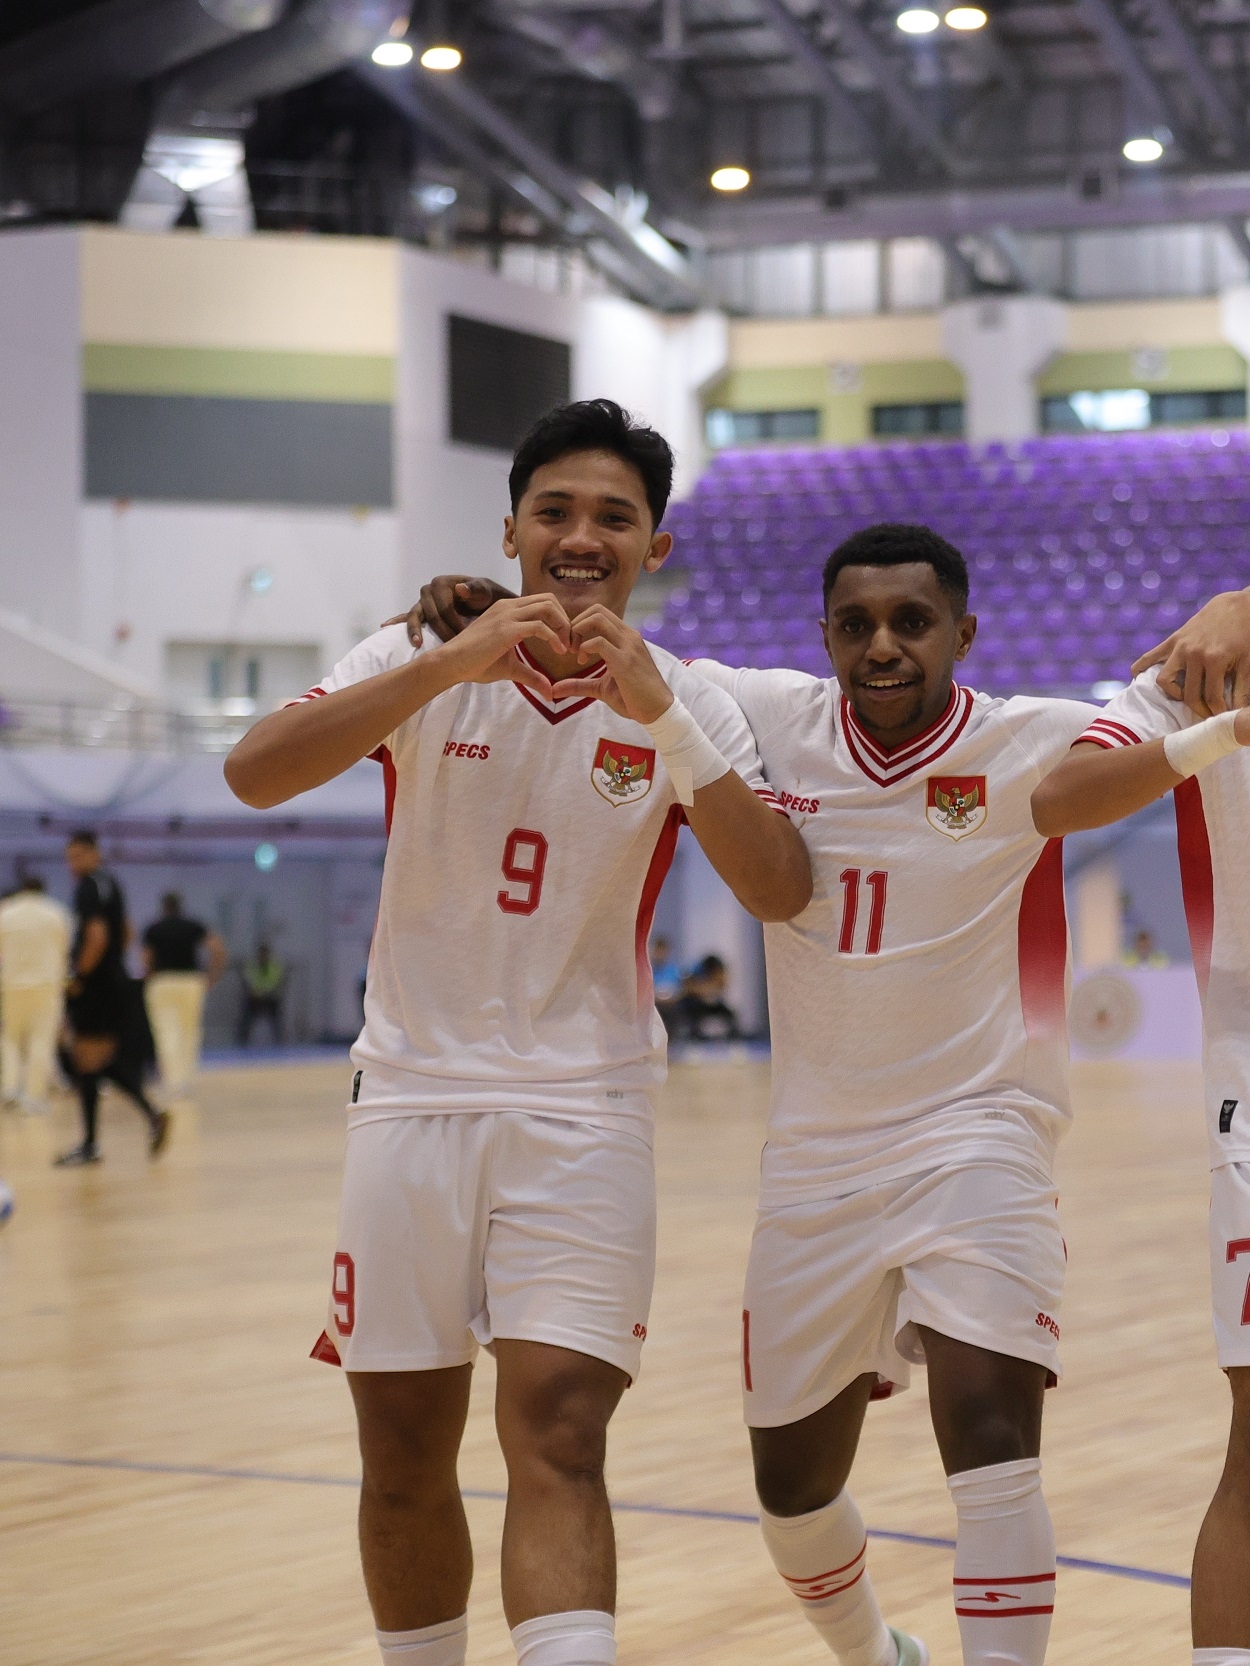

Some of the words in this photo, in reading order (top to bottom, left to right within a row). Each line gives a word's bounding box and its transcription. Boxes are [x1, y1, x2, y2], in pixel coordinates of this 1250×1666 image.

[780, 790, 820, 814] SPECS
[496, 827, 549, 917] 9
[838, 868, 889, 955] 11
[332, 1252, 355, 1338] 9
